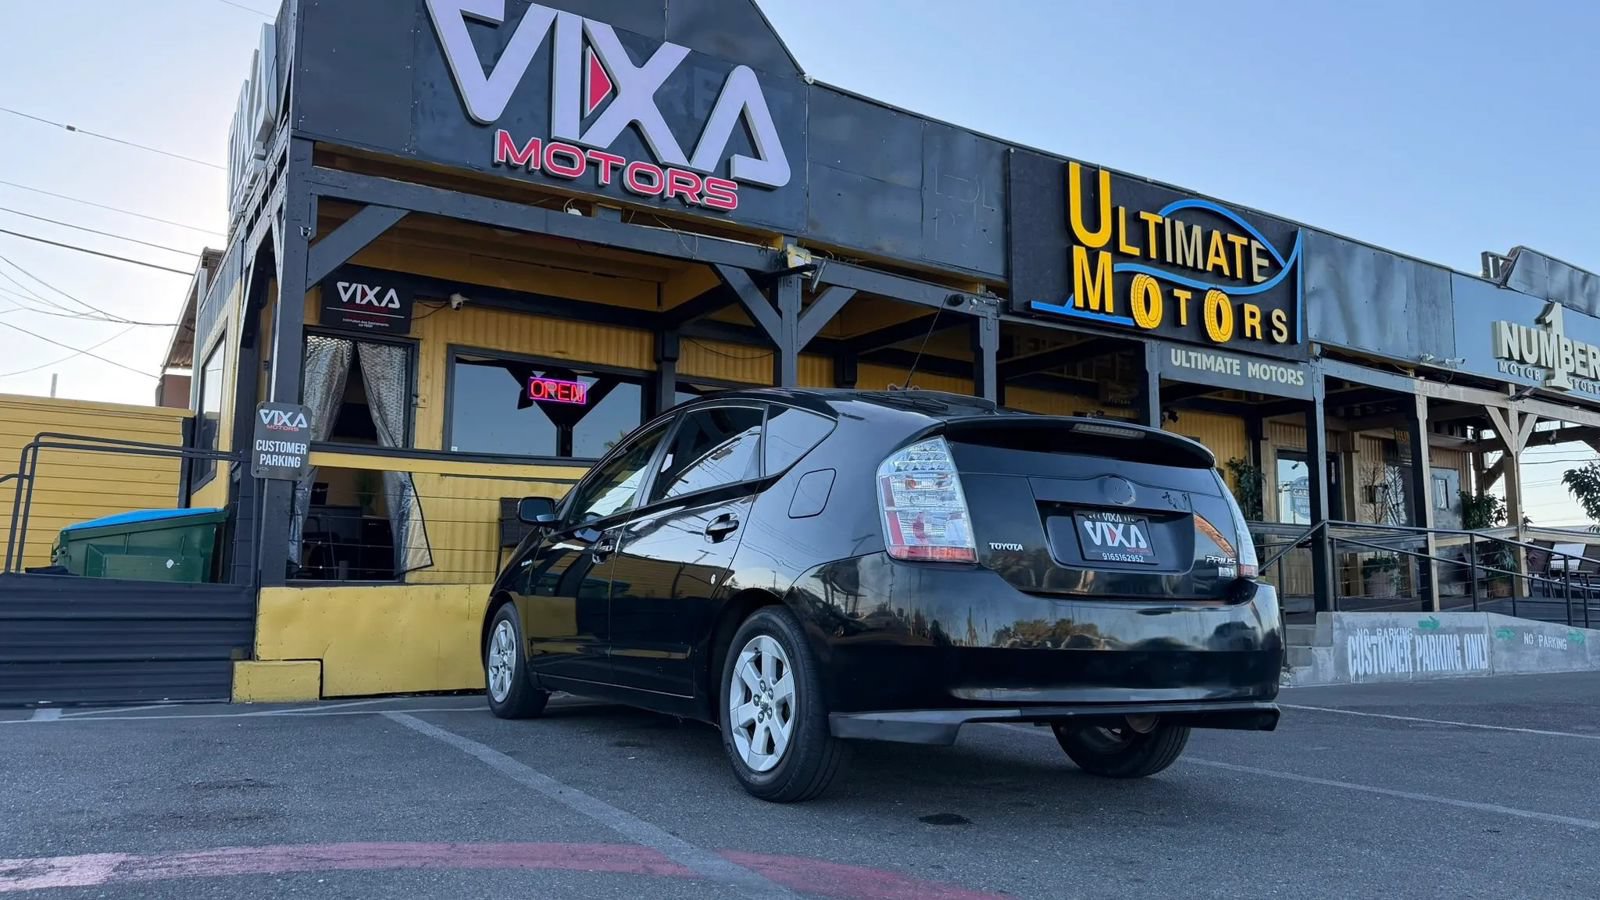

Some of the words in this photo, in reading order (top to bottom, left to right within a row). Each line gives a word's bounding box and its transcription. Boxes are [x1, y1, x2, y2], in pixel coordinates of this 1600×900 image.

[427, 0, 791, 188] VIXA
[494, 129, 738, 213] MOTORS
[1066, 161, 1270, 283] ULTIMATE
[336, 281, 401, 309] VIXA
[1072, 245, 1289, 344] MOTORS
[1494, 320, 1600, 381] NUMBER
[1171, 348, 1241, 376] ULTIMATE
[1247, 361, 1304, 386] MOTORS
[1498, 361, 1541, 381] MOTOR
[530, 380, 585, 402] OPEN
[259, 409, 308, 428] VIXA
[266, 424, 299, 432] MOTORS
[255, 439, 307, 455] CUSTOMER
[259, 453, 301, 468] PARKING
[1102, 512, 1122, 523] VIXA
[1083, 520, 1147, 549] VIXA
[988, 541, 1024, 551] TOYOTA
[1102, 552, 1145, 563] 9165162952
[1206, 555, 1237, 565] PRIUS
[1523, 632, 1534, 645] NO
[1538, 634, 1568, 650] PARKING
[1347, 635, 1413, 676] CUSTOMER
[1415, 635, 1462, 672] PARKING
[1464, 633, 1489, 670] ONLY
